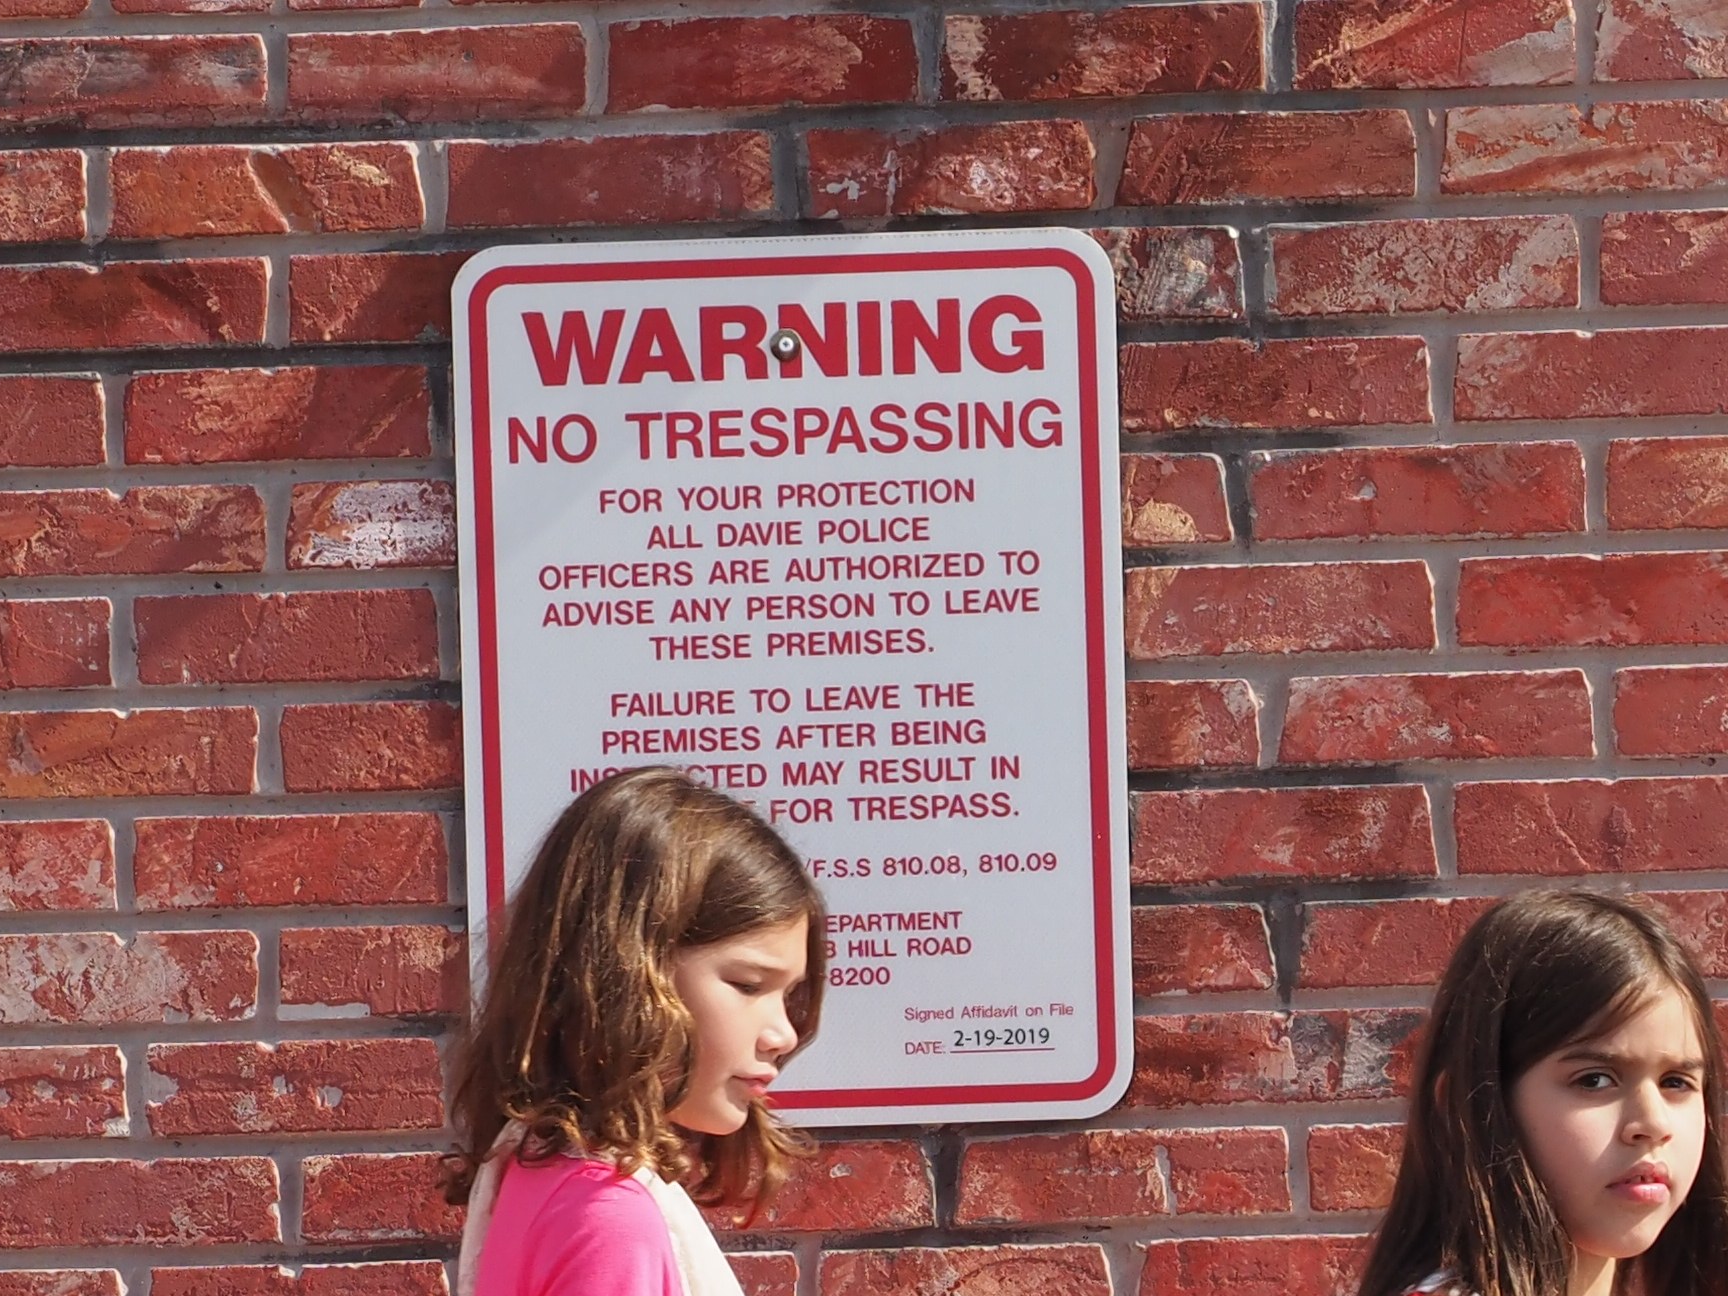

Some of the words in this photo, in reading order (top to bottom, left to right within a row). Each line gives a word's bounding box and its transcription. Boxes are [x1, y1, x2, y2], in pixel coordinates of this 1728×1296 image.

[520, 294, 1045, 387] WARNING
[507, 413, 598, 465] NO
[624, 398, 1063, 461] TRESPASSING
[599, 488, 663, 514] FOR
[677, 485, 762, 512] YOUR
[777, 478, 975, 509] PROTECTION
[646, 524, 704, 550] ALL
[716, 521, 803, 548] DAVIE
[818, 516, 931, 545] POLICE
[538, 560, 694, 591] OFFICERS
[708, 558, 770, 585] ARE
[784, 552, 985, 583] AUTHORIZED
[997, 550, 1040, 576] TO
[542, 599, 655, 628] ADVISE
[669, 597, 732, 624] ANY
[746, 592, 875, 621] PERSON
[888, 590, 931, 617] TO
[944, 587, 1040, 615] LEAVE
[648, 633, 752, 661] THESE
[767, 627, 936, 658] PREMISES.
[610, 689, 736, 718] FAILURE
[749, 687, 791, 714] TO
[805, 684, 901, 712] LEAVE
[913, 682, 975, 708] THE
[601, 725, 761, 756] PREMISES
[775, 721, 877, 750] AFTER
[890, 718, 987, 747] BEING
[570, 762, 768, 794] INCTED
[782, 759, 845, 787] MAY
[859, 756, 977, 785] RESULT
[990, 755, 1020, 781] IN
[770, 797, 833, 825] FOR
[846, 791, 1020, 822] TRESPASS.
[882, 855, 969, 879] 810.08,
[978, 852, 1057, 874] 810.09
[824, 910, 963, 934] EPARTMENT
[847, 938, 898, 959] HILL
[906, 936, 972, 958] ROAD
[903, 1005, 955, 1024] Signed
[960, 1004, 1019, 1020] Affidavit
[1024, 1005, 1044, 1018] on
[1049, 1002, 1075, 1017] File
[952, 1027, 1051, 1048] 2-19-2019
